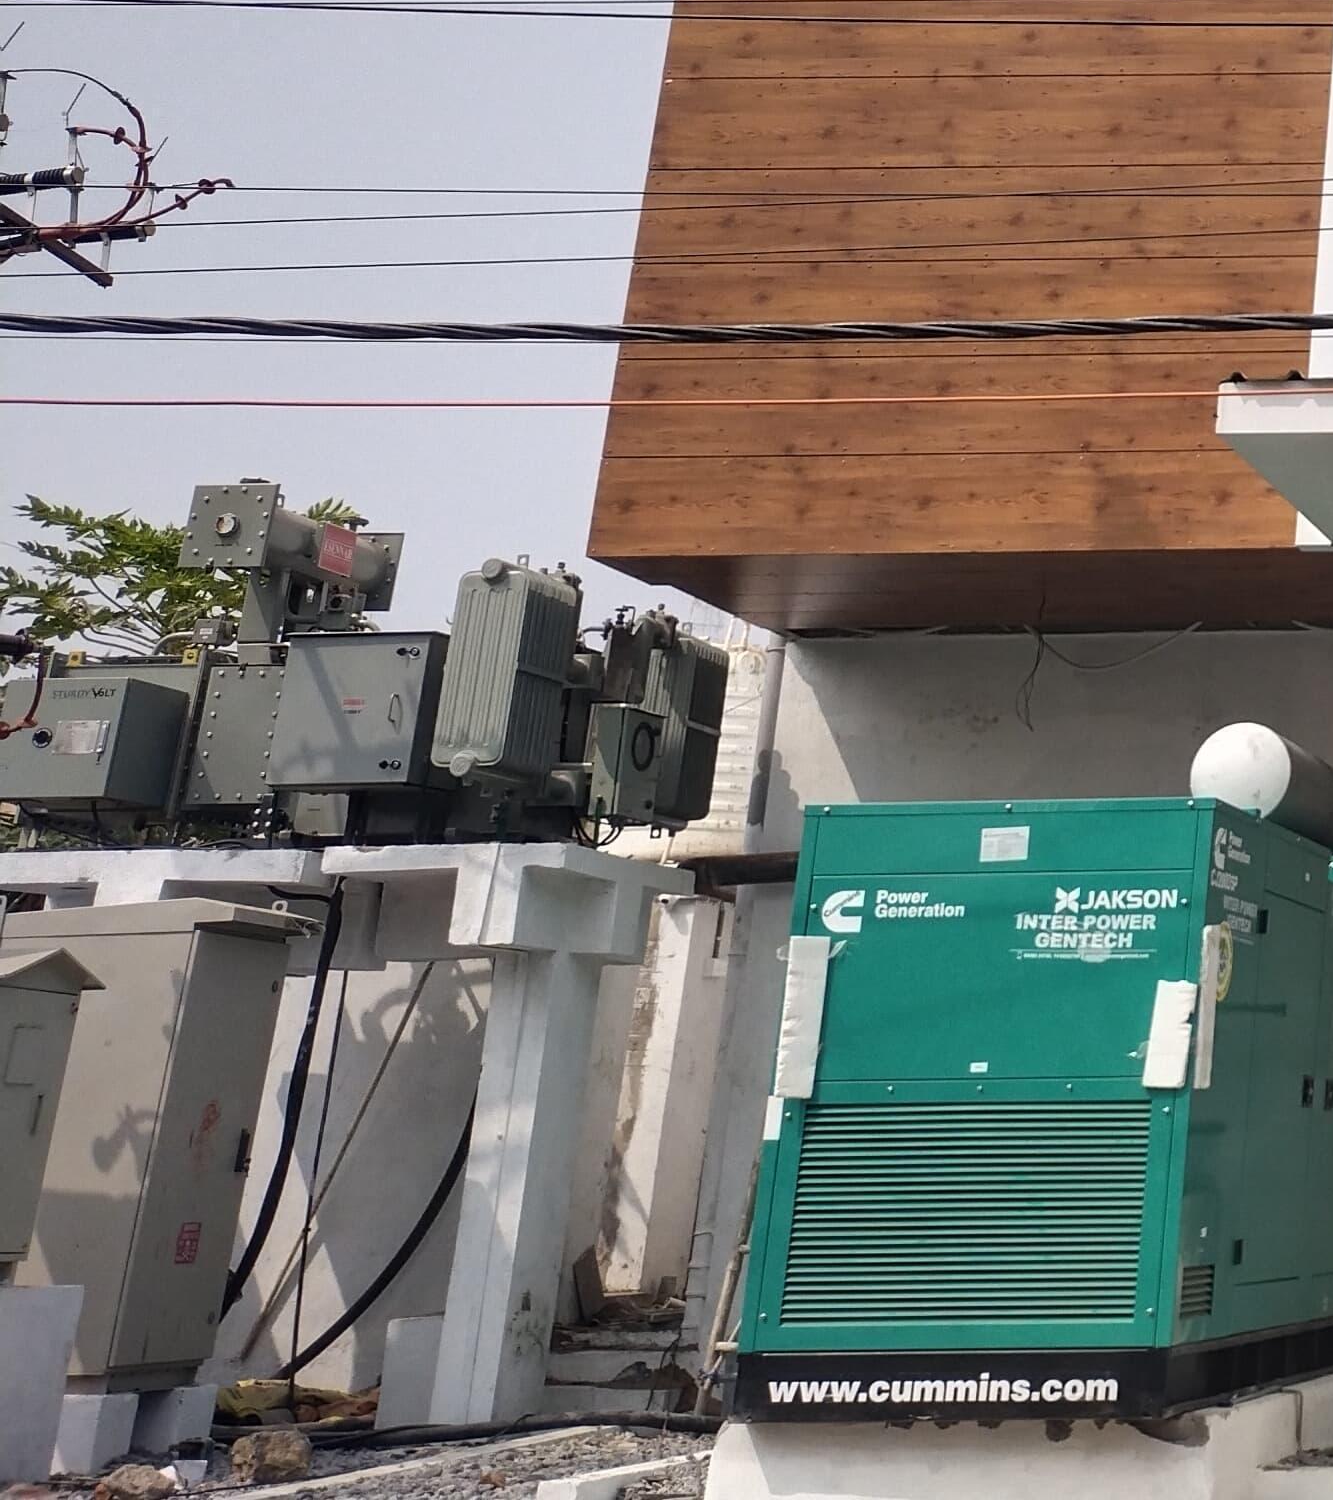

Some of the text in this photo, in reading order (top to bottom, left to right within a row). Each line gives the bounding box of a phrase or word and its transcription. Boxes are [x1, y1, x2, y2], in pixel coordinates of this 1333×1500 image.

[876, 890, 928, 904] Power
[1081, 889, 1178, 910] JAKSON
[875, 903, 965, 919] Generation
[1015, 914, 1156, 930] INTER POWER
[1035, 932, 1133, 948] GENTECH
[769, 1373, 1118, 1403] www.cummins.com
